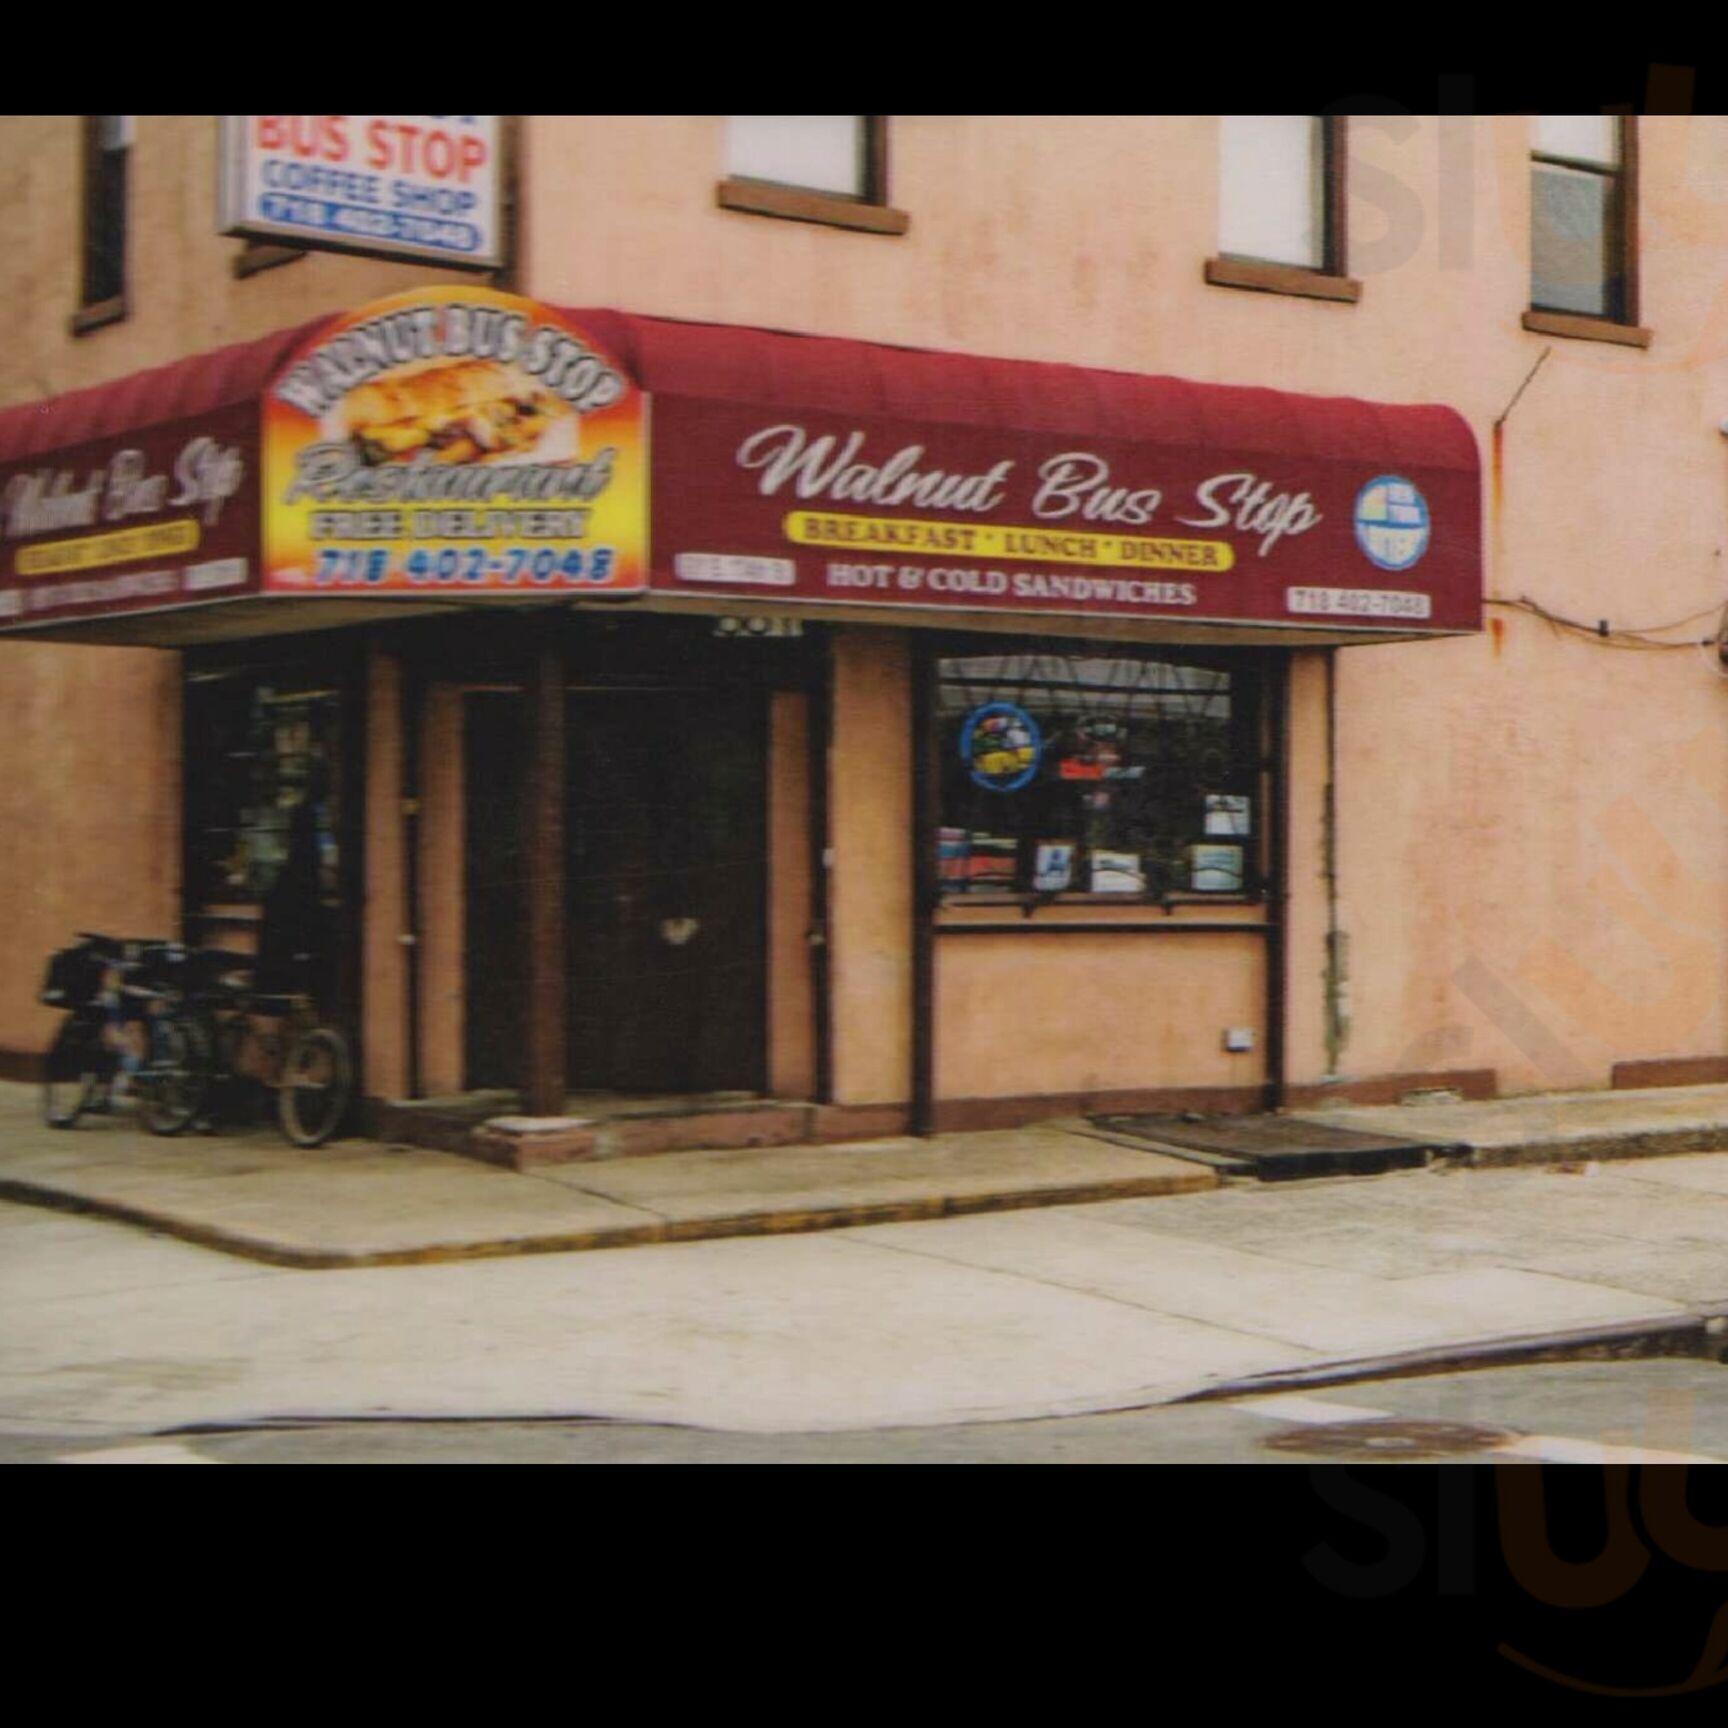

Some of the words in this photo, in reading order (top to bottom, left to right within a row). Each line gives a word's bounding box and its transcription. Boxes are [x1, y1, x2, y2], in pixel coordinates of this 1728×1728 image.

[257, 115, 350, 162] BUS
[366, 119, 488, 183] STOP
[262, 159, 380, 204] COFFEE
[393, 181, 477, 216] SHOP
[274, 305, 440, 418] WALNUT
[443, 302, 532, 365] BUS
[524, 325, 626, 414] STOP
[280, 440, 618, 506] Restaurant
[736, 424, 1013, 514] Walnut
[1031, 451, 1163, 527] Bus
[1174, 472, 1323, 557] Stop
[308, 508, 403, 541] FREE
[409, 508, 594, 540] DELIVERY
[803, 517, 978, 550] BREAKFAST
[1003, 532, 1100, 560] LUNCH
[1116, 539, 1221, 568] DINNER
[315, 546, 391, 585] 718
[404, 546, 616, 585] 402-7048
[826, 562, 896, 589] HOT
[899, 565, 922, 589] &
[927, 567, 1009, 594] COLD
[1011, 573, 1198, 606] SANDWICHES
